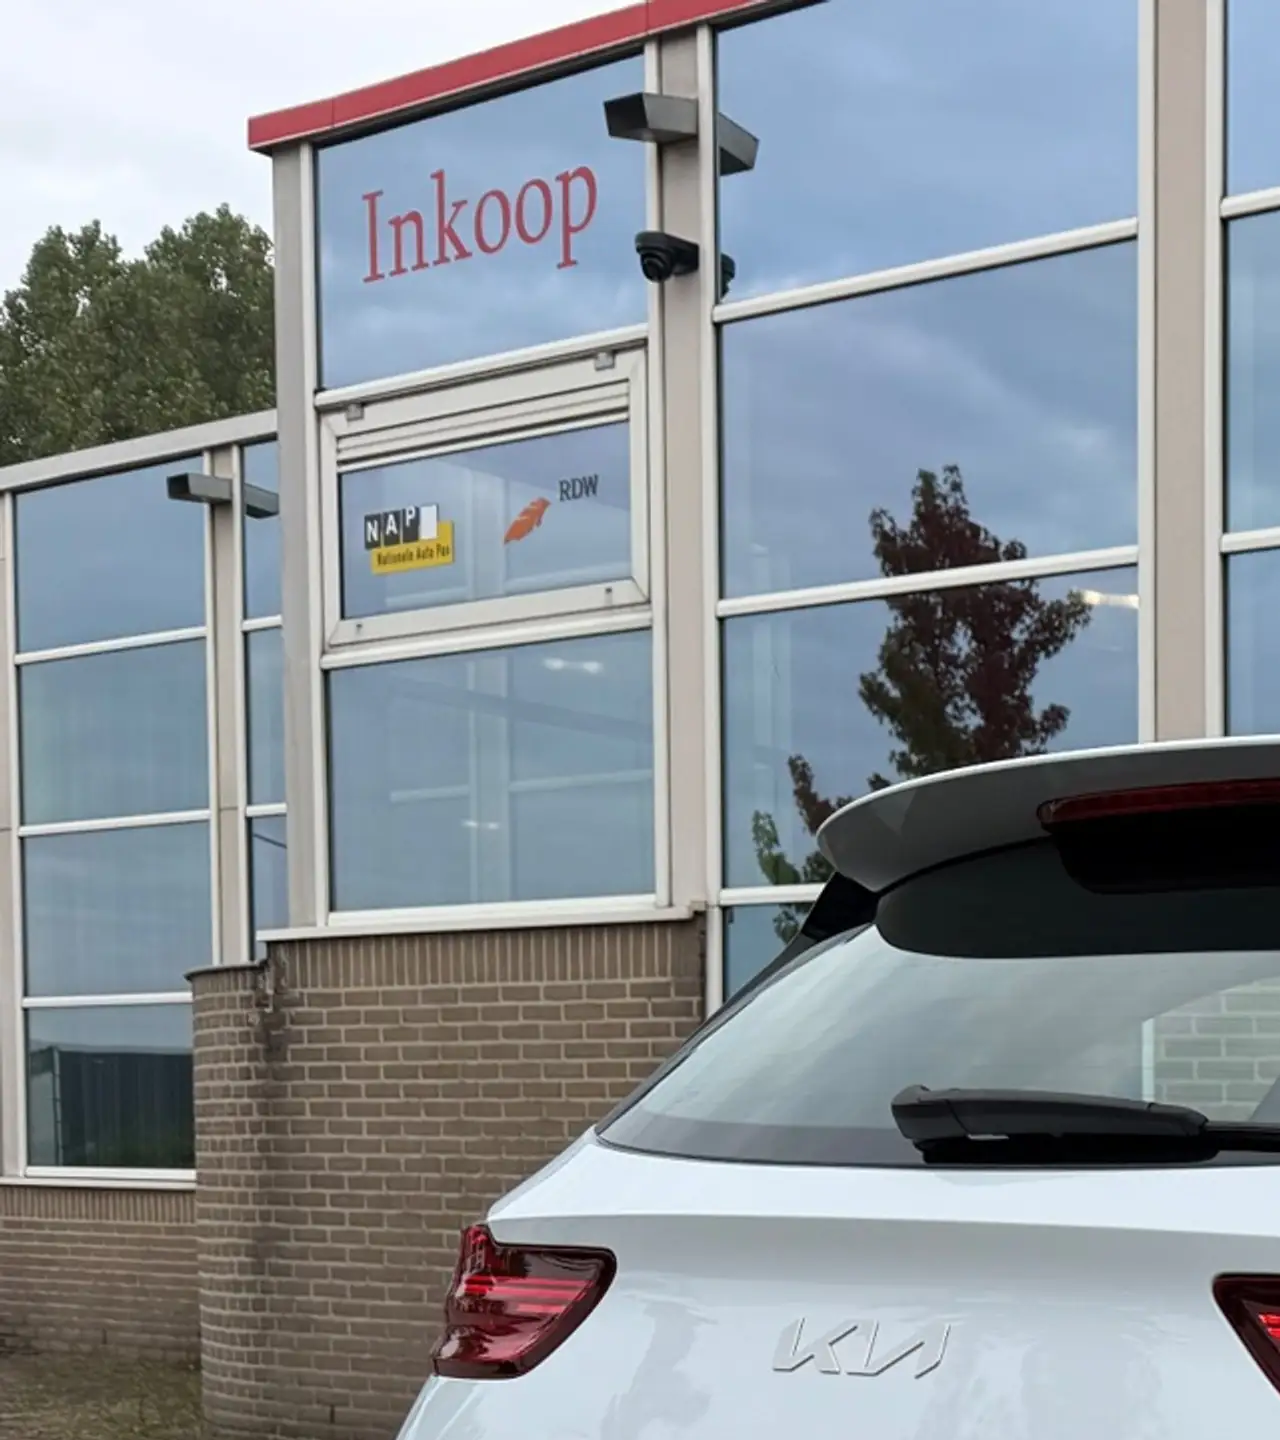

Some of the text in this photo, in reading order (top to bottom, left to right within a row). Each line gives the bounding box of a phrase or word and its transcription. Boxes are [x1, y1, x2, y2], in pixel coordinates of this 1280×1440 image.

[362, 165, 598, 284] Inkoop
[559, 473, 599, 502] RDW
[365, 505, 418, 544] NAP
[772, 1316, 952, 1380] KIA
